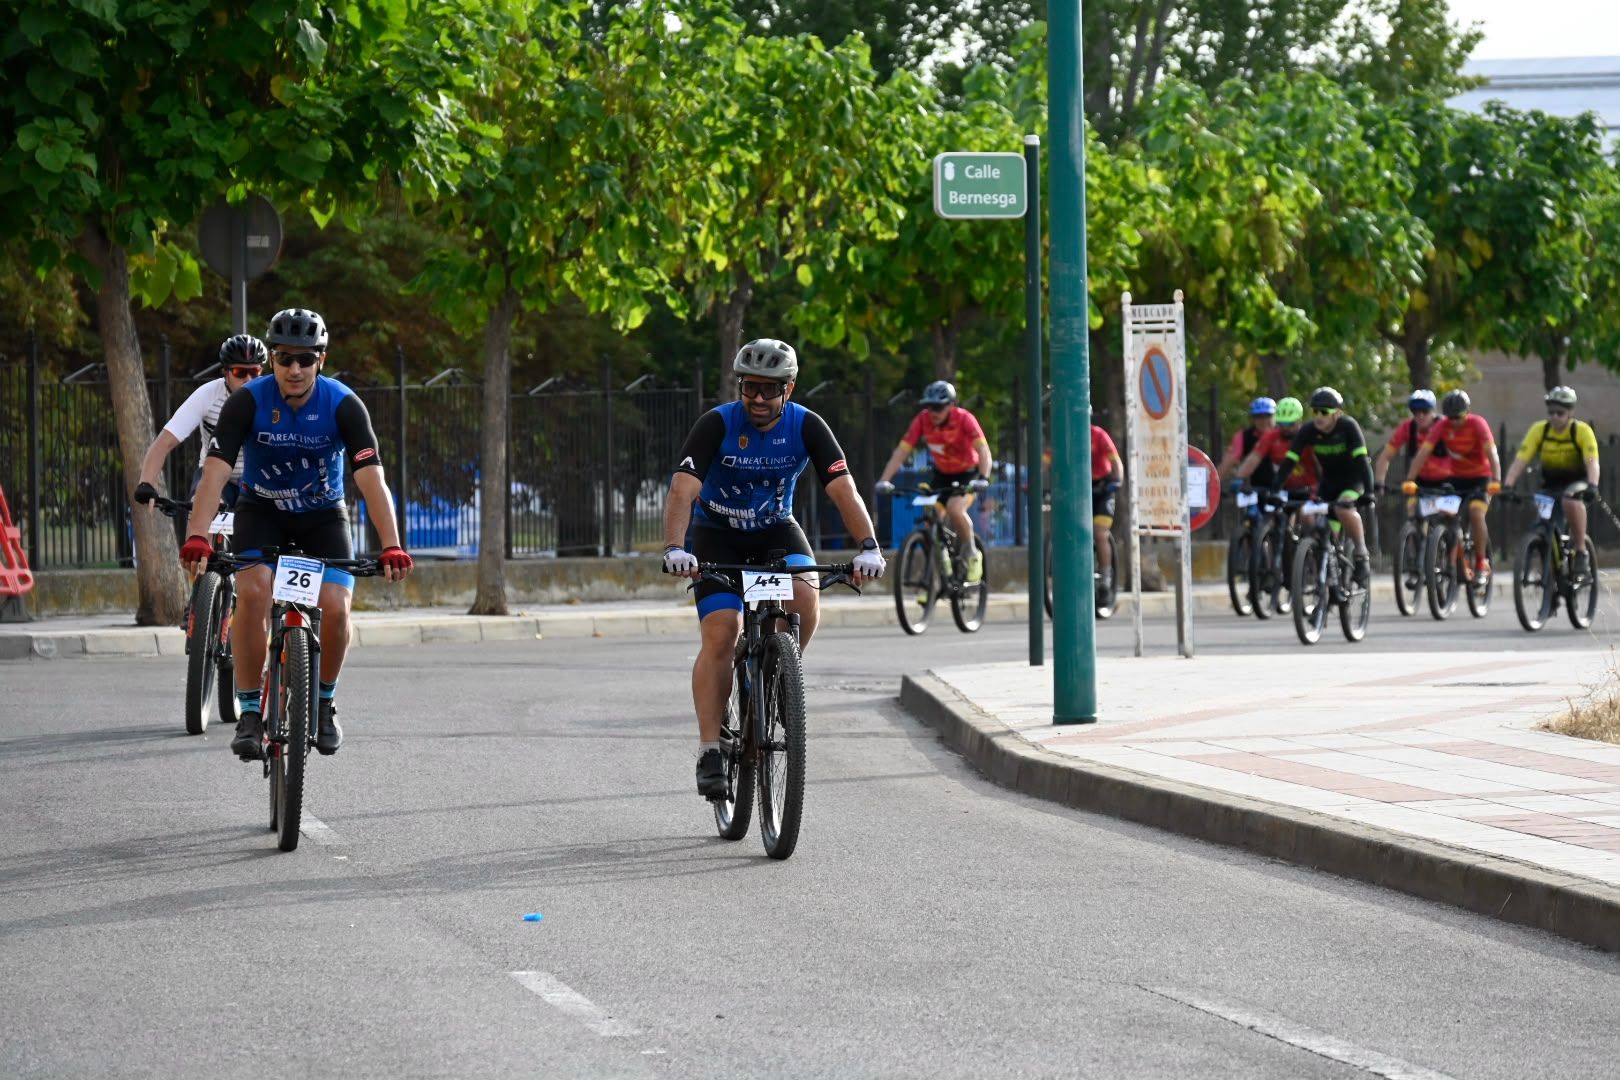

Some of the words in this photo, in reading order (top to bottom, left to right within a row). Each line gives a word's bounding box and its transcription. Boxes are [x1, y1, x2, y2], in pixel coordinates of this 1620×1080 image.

[964, 164, 1001, 179] Calle
[949, 190, 1017, 208] Bernesga
[709, 500, 756, 519] RUNNING
[286, 570, 311, 588] 26
[755, 575, 781, 587] 44
